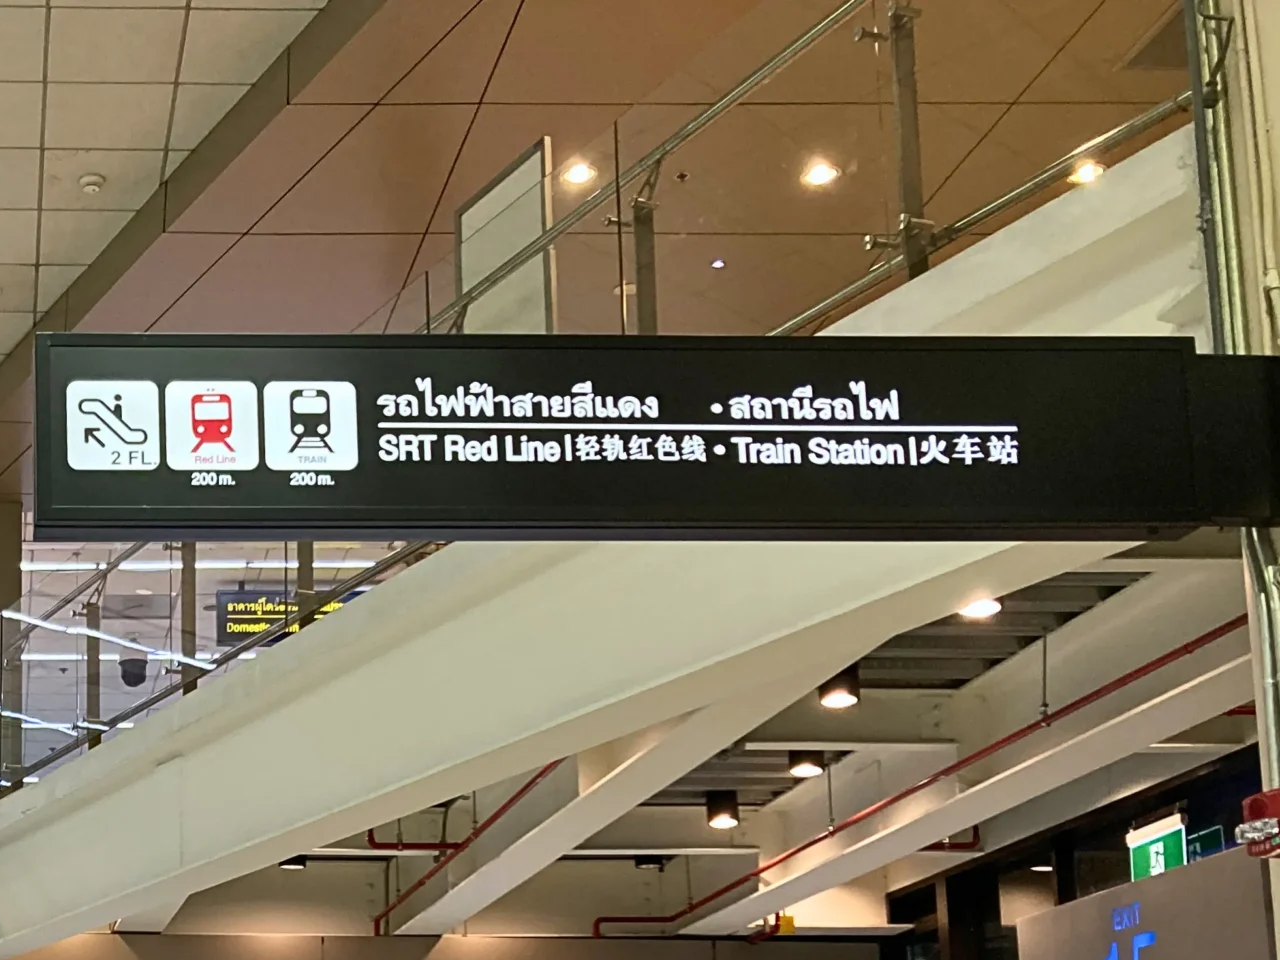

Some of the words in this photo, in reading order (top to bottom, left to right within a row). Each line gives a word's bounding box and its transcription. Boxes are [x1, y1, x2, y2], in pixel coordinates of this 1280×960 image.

[376, 377, 659, 419] รถไฟฟ้าสายสีแดง
[728, 380, 900, 421] สถานีรถไฟ
[378, 434, 438, 462] SRT
[444, 434, 498, 462] Red
[505, 434, 562, 463] Line
[575, 433, 707, 463] 轻轨红色线
[730, 436, 802, 465] Train
[808, 437, 905, 465] Station
[919, 434, 1019, 465] 火车站
[111, 451, 122, 466] 2
[194, 455, 213, 464] Red
[215, 455, 236, 464] Line
[297, 455, 328, 464] TRAIN
[191, 473, 218, 486] 200
[290, 473, 317, 486] 200
[1112, 902, 1141, 931] EXIT
